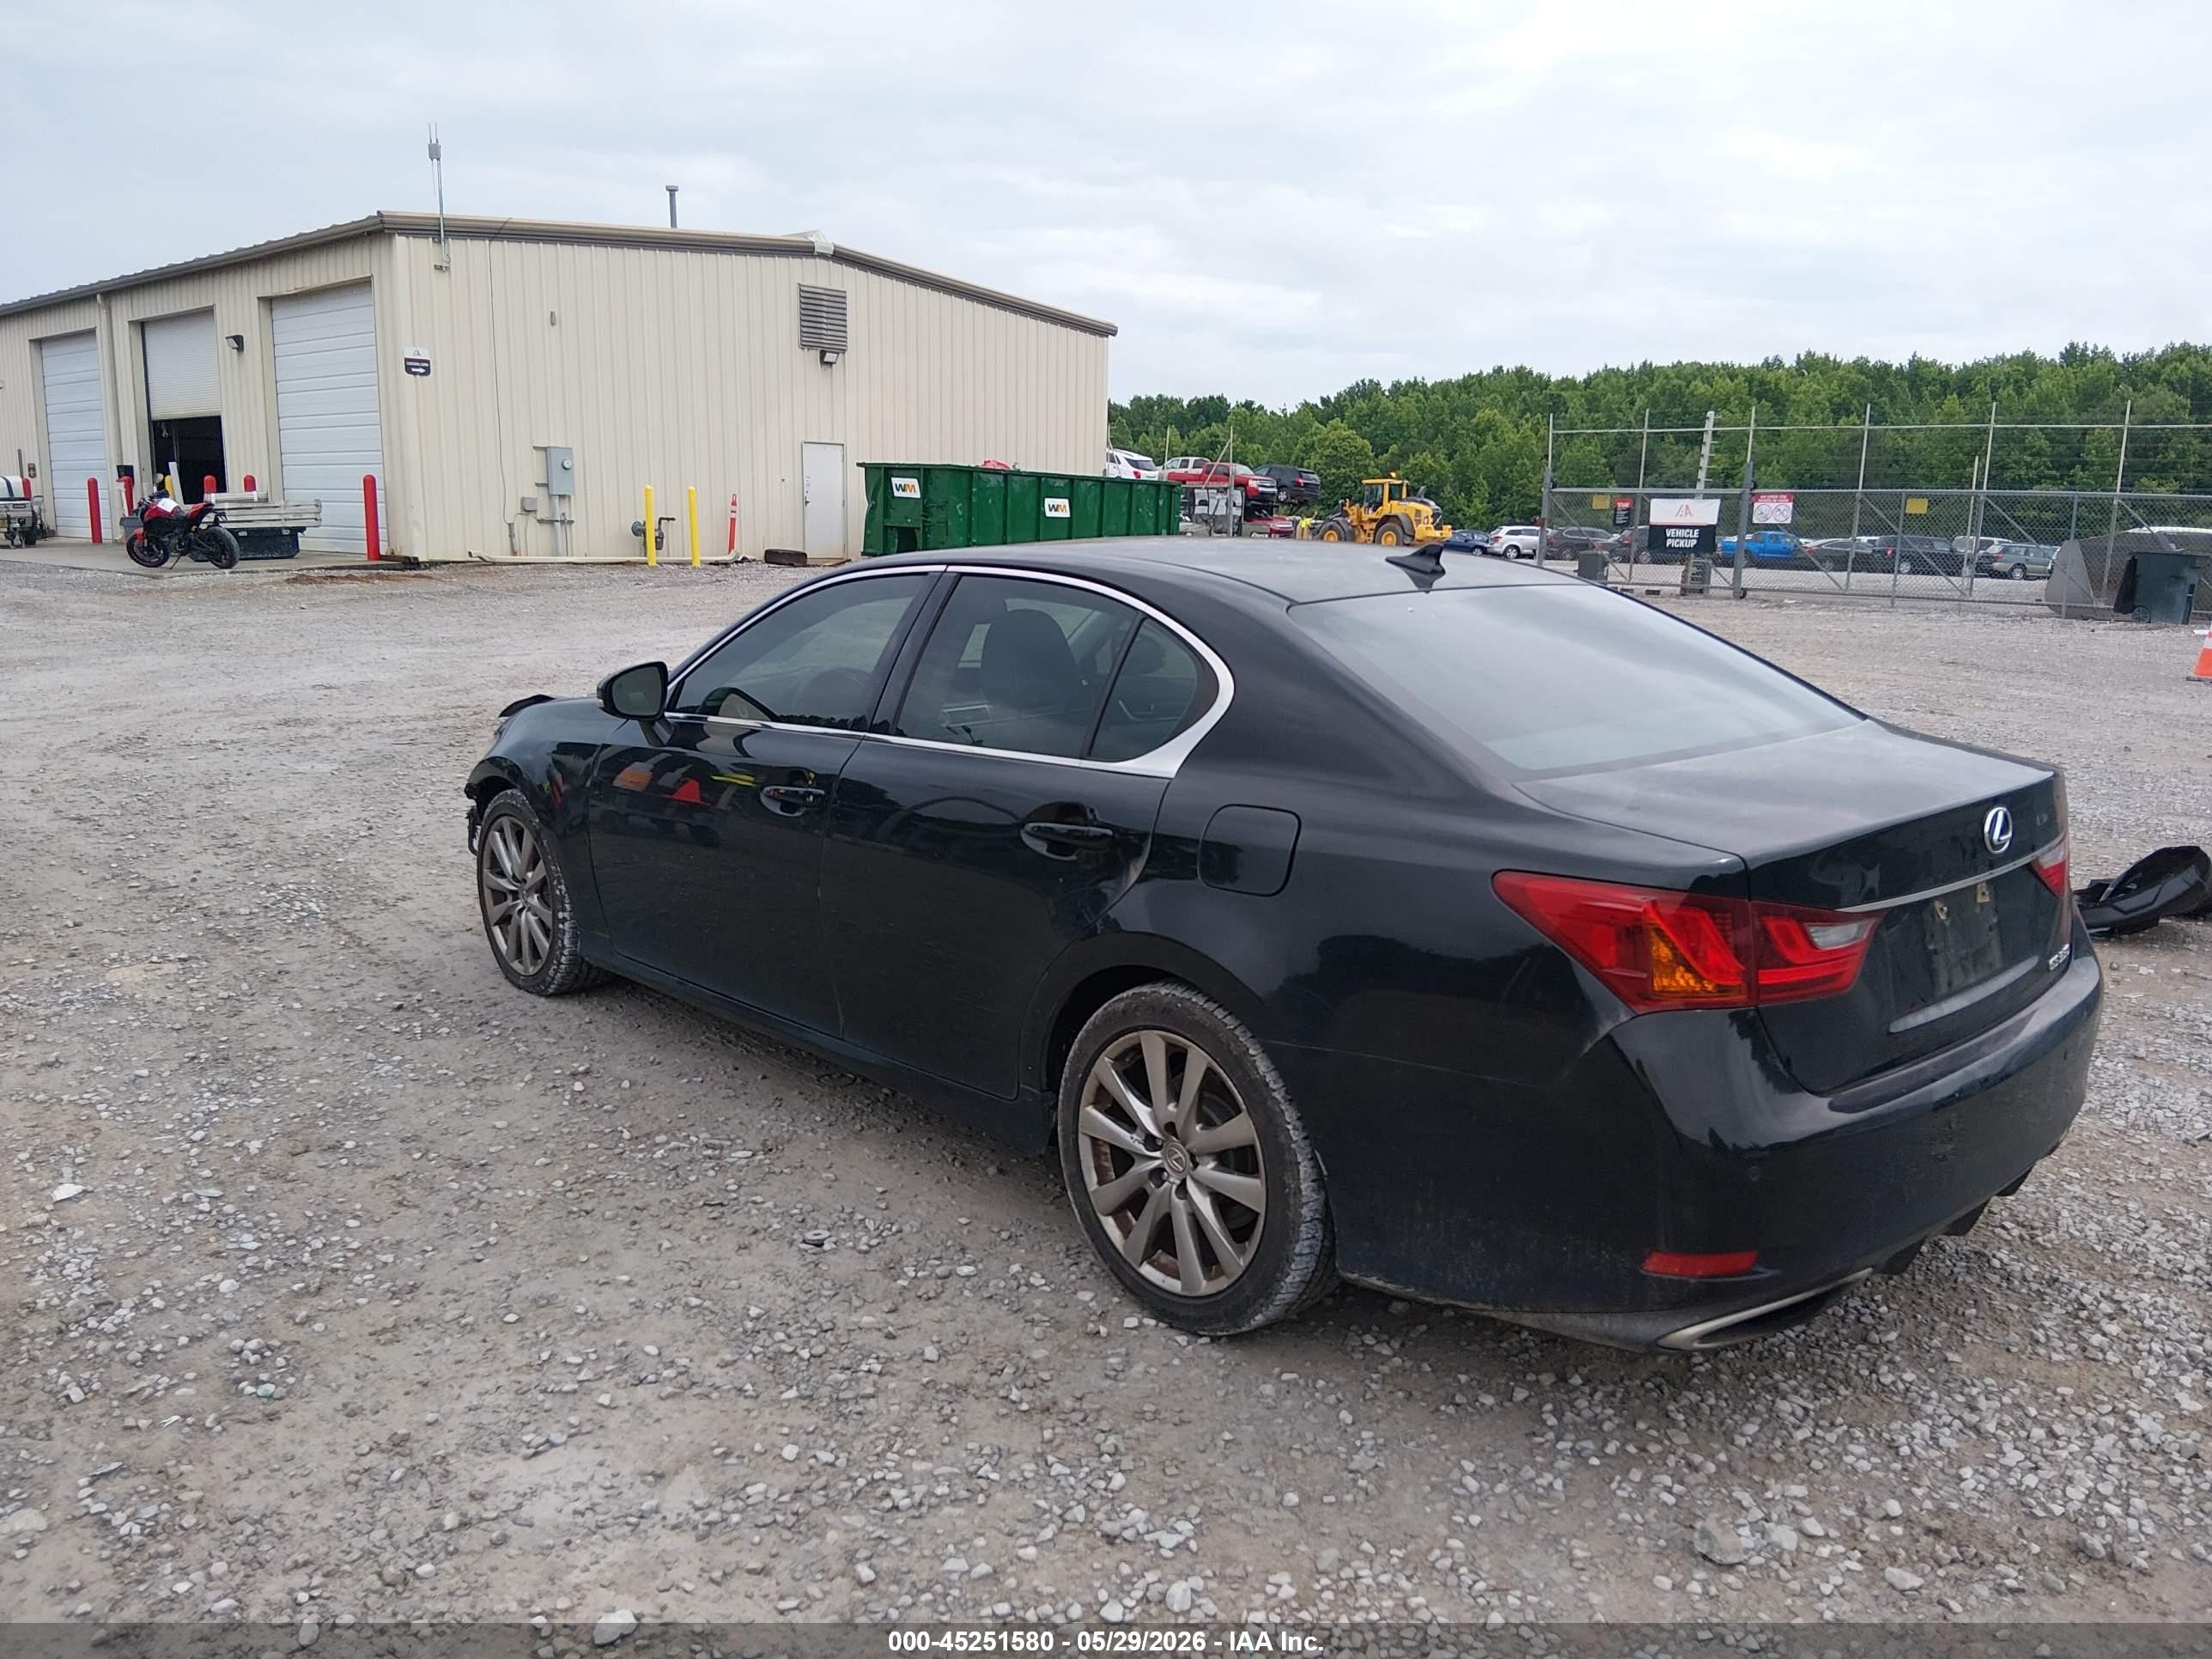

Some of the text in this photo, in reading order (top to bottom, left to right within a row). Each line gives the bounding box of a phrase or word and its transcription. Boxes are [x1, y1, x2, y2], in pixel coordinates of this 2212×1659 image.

[894, 483, 917, 494] WM
[1048, 503, 1068, 514] WM
[1665, 528, 1700, 538] VEHICLE
[1665, 538, 1698, 548] PICKUP
